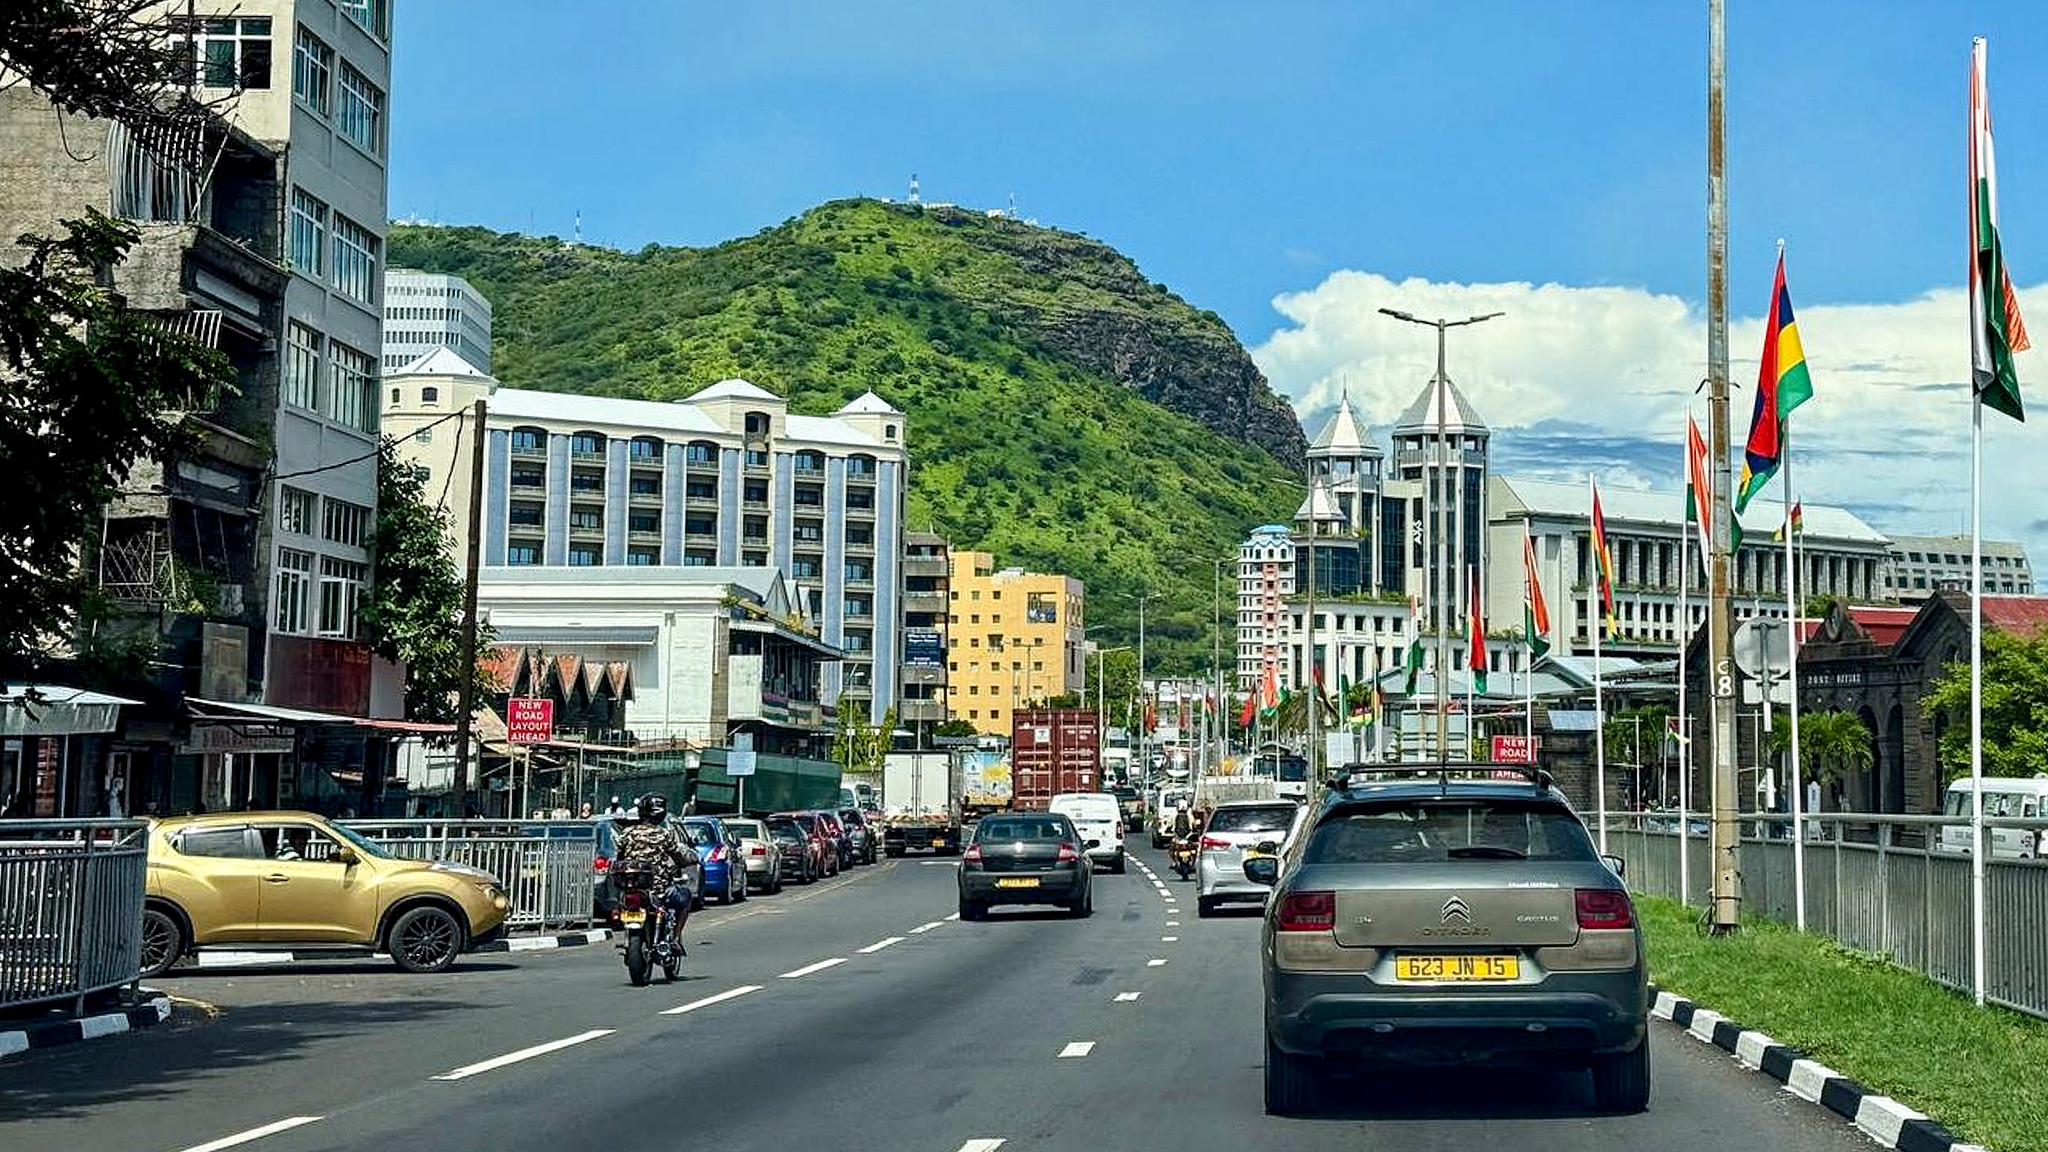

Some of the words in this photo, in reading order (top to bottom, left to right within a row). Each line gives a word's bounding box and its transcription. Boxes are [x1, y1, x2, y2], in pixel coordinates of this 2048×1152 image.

[518, 701, 542, 710] NEW
[515, 711, 544, 721] ROAD
[511, 721, 549, 731] LAYOUT
[511, 732, 546, 741] AHEAD
[1502, 738, 1526, 747] NEW
[1409, 957, 1443, 976] 623
[1452, 957, 1474, 976] JN
[1484, 957, 1505, 976] 15
